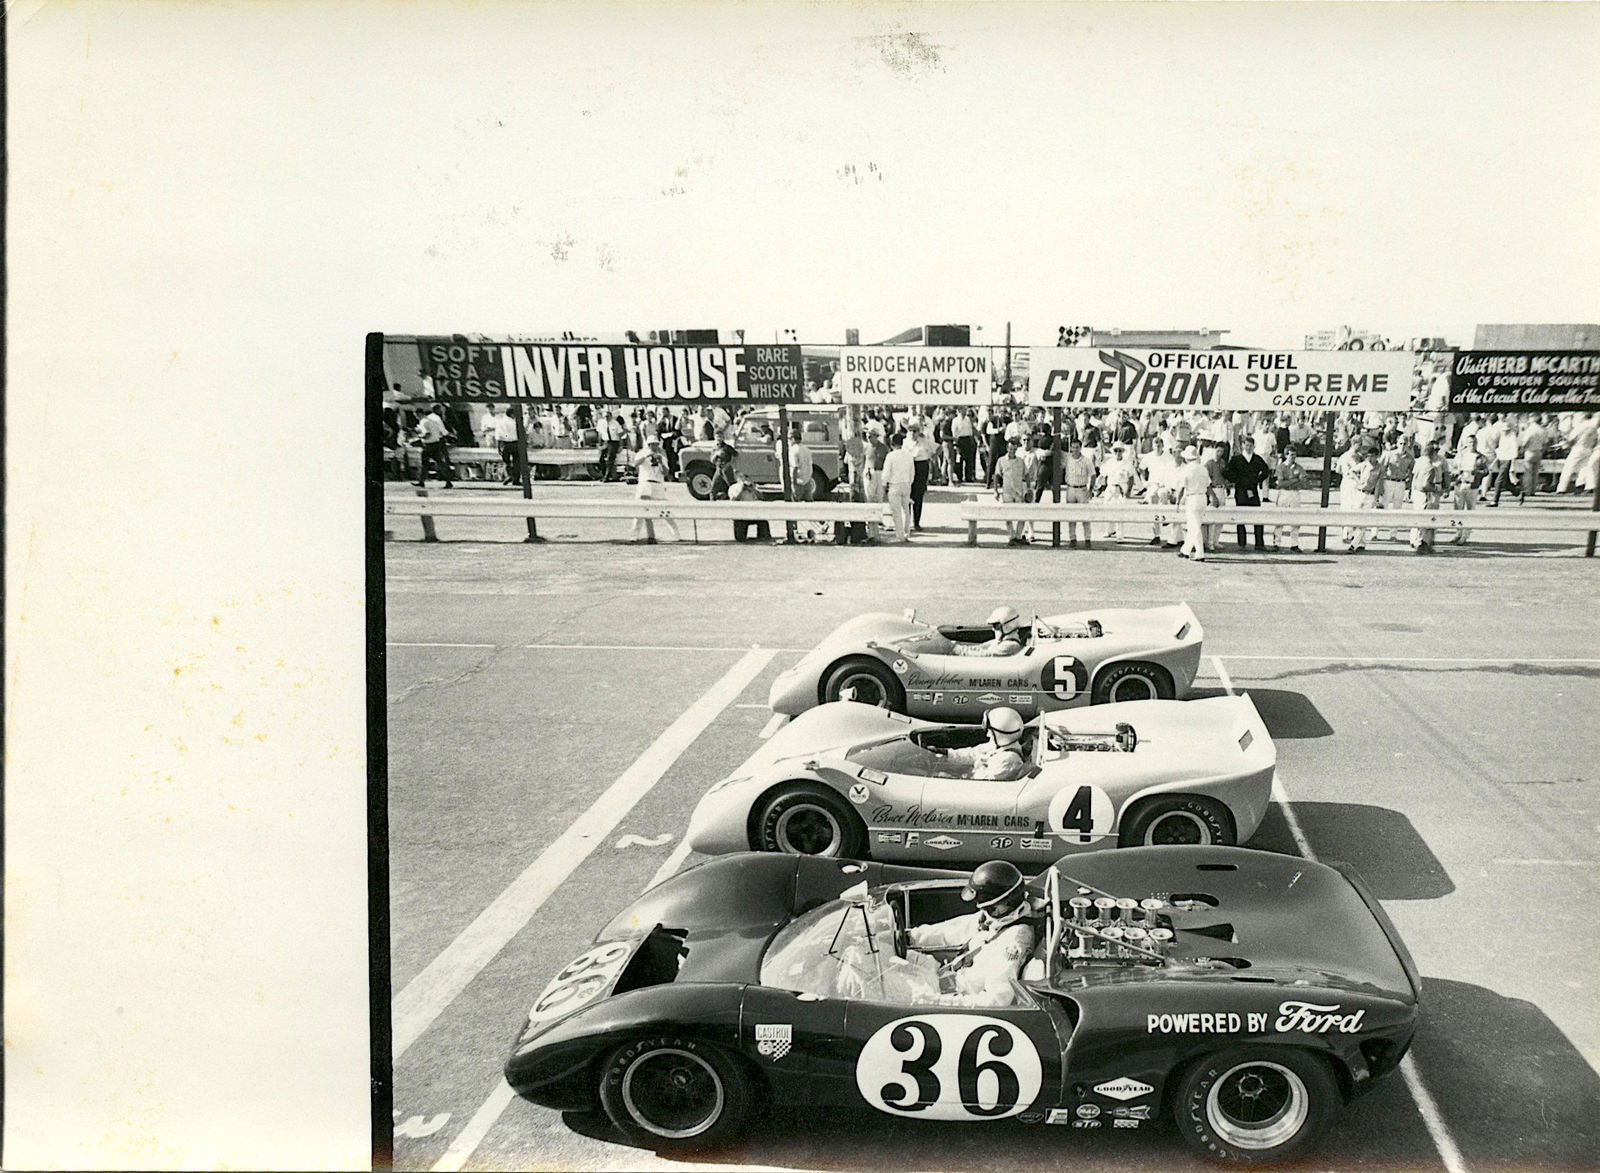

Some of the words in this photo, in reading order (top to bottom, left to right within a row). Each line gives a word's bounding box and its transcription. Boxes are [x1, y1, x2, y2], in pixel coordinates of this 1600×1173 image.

[431, 345, 498, 363] SOFT
[756, 347, 789, 363] RARE
[1148, 352, 1239, 370] OFFICIAL
[1247, 354, 1298, 370] FUEL
[436, 363, 461, 379] AS
[466, 363, 480, 379] A
[500, 345, 618, 398] INVER
[624, 345, 749, 399] HOUSE
[750, 365, 798, 381] SCOTCH
[846, 355, 986, 374] BRIDGEHAMPTON
[1455, 355, 1489, 375] Visit
[1487, 356, 1528, 374] HERB
[852, 377, 896, 394] RACE
[912, 378, 979, 395] CIRCUIT
[1042, 350, 1220, 406] CHEVRON
[1244, 373, 1389, 392] SUPREME
[1477, 375, 1492, 386] OF
[1493, 375, 1544, 386] BOWDEN
[1547, 375, 1599, 387] SQUARE
[436, 380, 501, 397] KISS
[750, 382, 798, 399] WHISKY
[1482, 387, 1520, 404] Circuit
[1521, 387, 1551, 403] Club
[1272, 394, 1361, 406] GASOLINE
[1007, 678, 1029, 688] CARS
[1053, 658, 1075, 699] 5
[871, 804, 905, 823] Bruce
[1004, 815, 1030, 827] CARS
[1062, 785, 1094, 842] 4
[990, 837, 1012, 849] STP
[1148, 1013, 1241, 1034] POWERED
[1247, 1013, 1268, 1033] BY
[1275, 1001, 1366, 1034] Ford
[757, 1026, 789, 1039] CASTROL
[880, 1020, 1020, 1117] 36
[1096, 1084, 1152, 1093] GOODYEAR
[1074, 1119, 1099, 1128] STP
